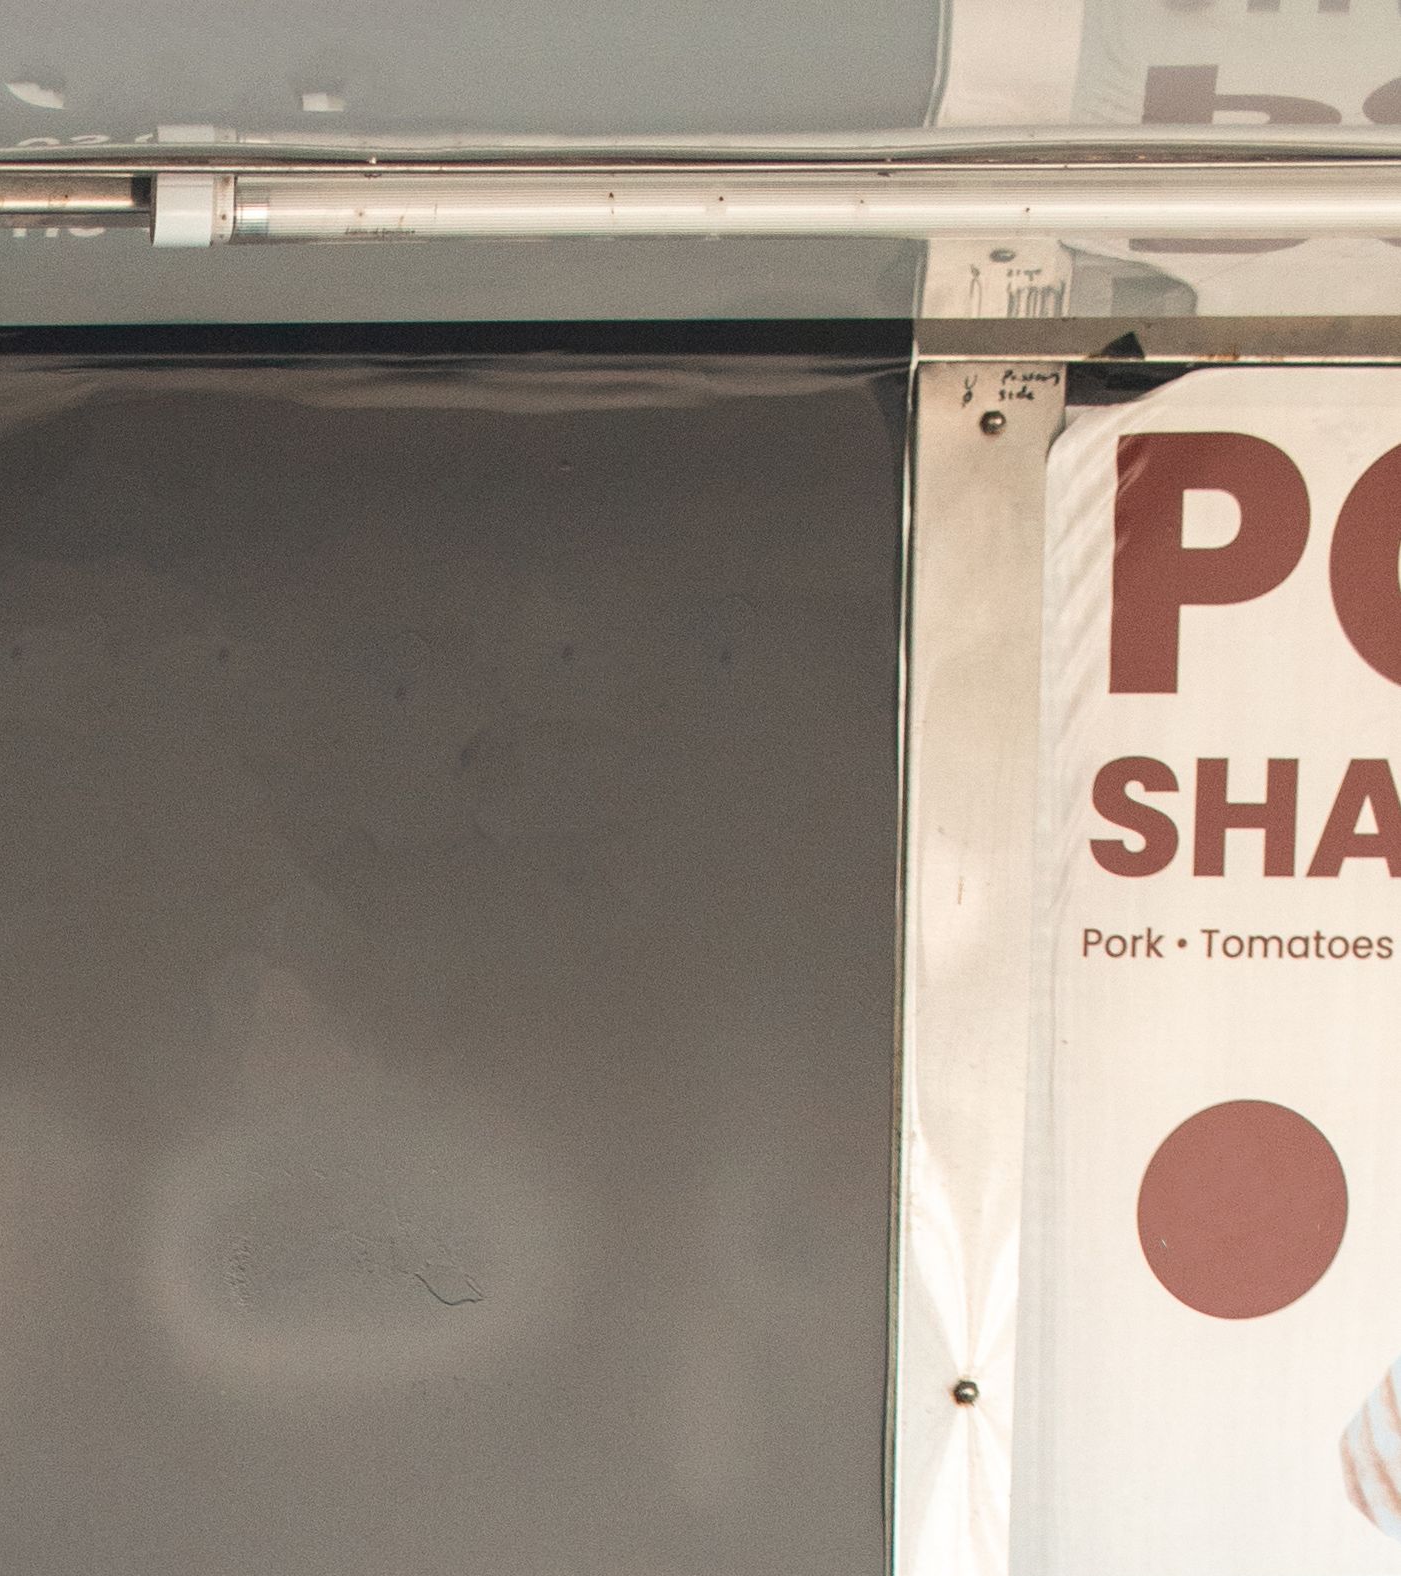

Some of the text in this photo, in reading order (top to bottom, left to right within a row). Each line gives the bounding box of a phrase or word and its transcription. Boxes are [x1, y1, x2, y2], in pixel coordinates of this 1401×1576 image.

[1090, 756, 1401, 878] SHA
[1083, 927, 1393, 959] Pork Tomatoes
